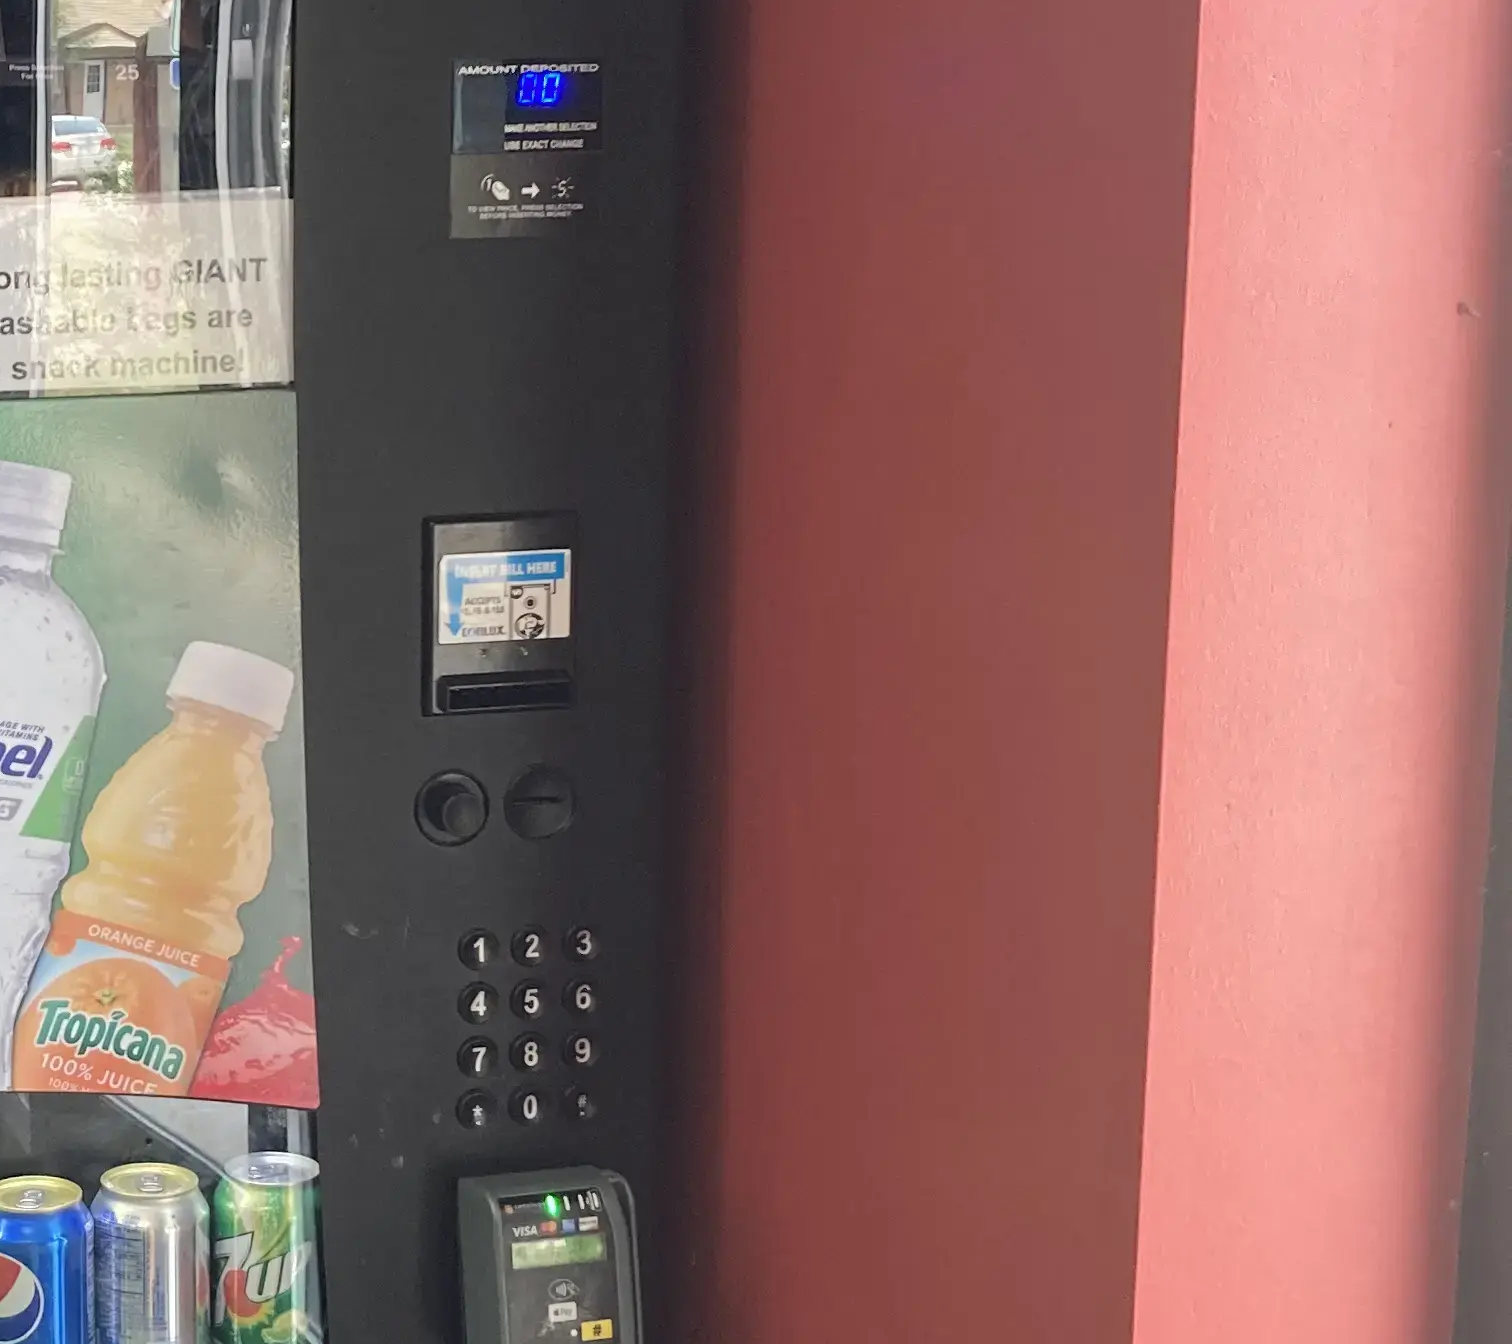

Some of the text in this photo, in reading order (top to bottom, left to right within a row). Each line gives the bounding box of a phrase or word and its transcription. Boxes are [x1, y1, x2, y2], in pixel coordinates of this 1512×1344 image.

[116, 64, 139, 81] 25
[458, 63, 600, 76] AMOUNT DEPOSITED
[171, 257, 268, 286] GIANT
[208, 308, 253, 329] are
[12, 354, 101, 380] snack
[500, 562, 524, 576] BILL
[526, 561, 557, 574] HERE
[21, 721, 46, 734] WITH
[88, 924, 201, 968] ORANGE JUICE
[473, 937, 485, 963] 1
[525, 933, 540, 959] 2
[575, 929, 592, 955] 3
[470, 991, 487, 1016] 4
[523, 988, 540, 1014] 5
[575, 984, 592, 1009] 6
[36, 999, 185, 1081] Tropicana
[575, 1037, 591, 1063] 9
[472, 1046, 487, 1072] 7
[523, 1041, 539, 1067] 8
[41, 1053, 159, 1095] 100% JUICE
[522, 1094, 538, 1120] 0
[512, 1225, 538, 1238] VISA
